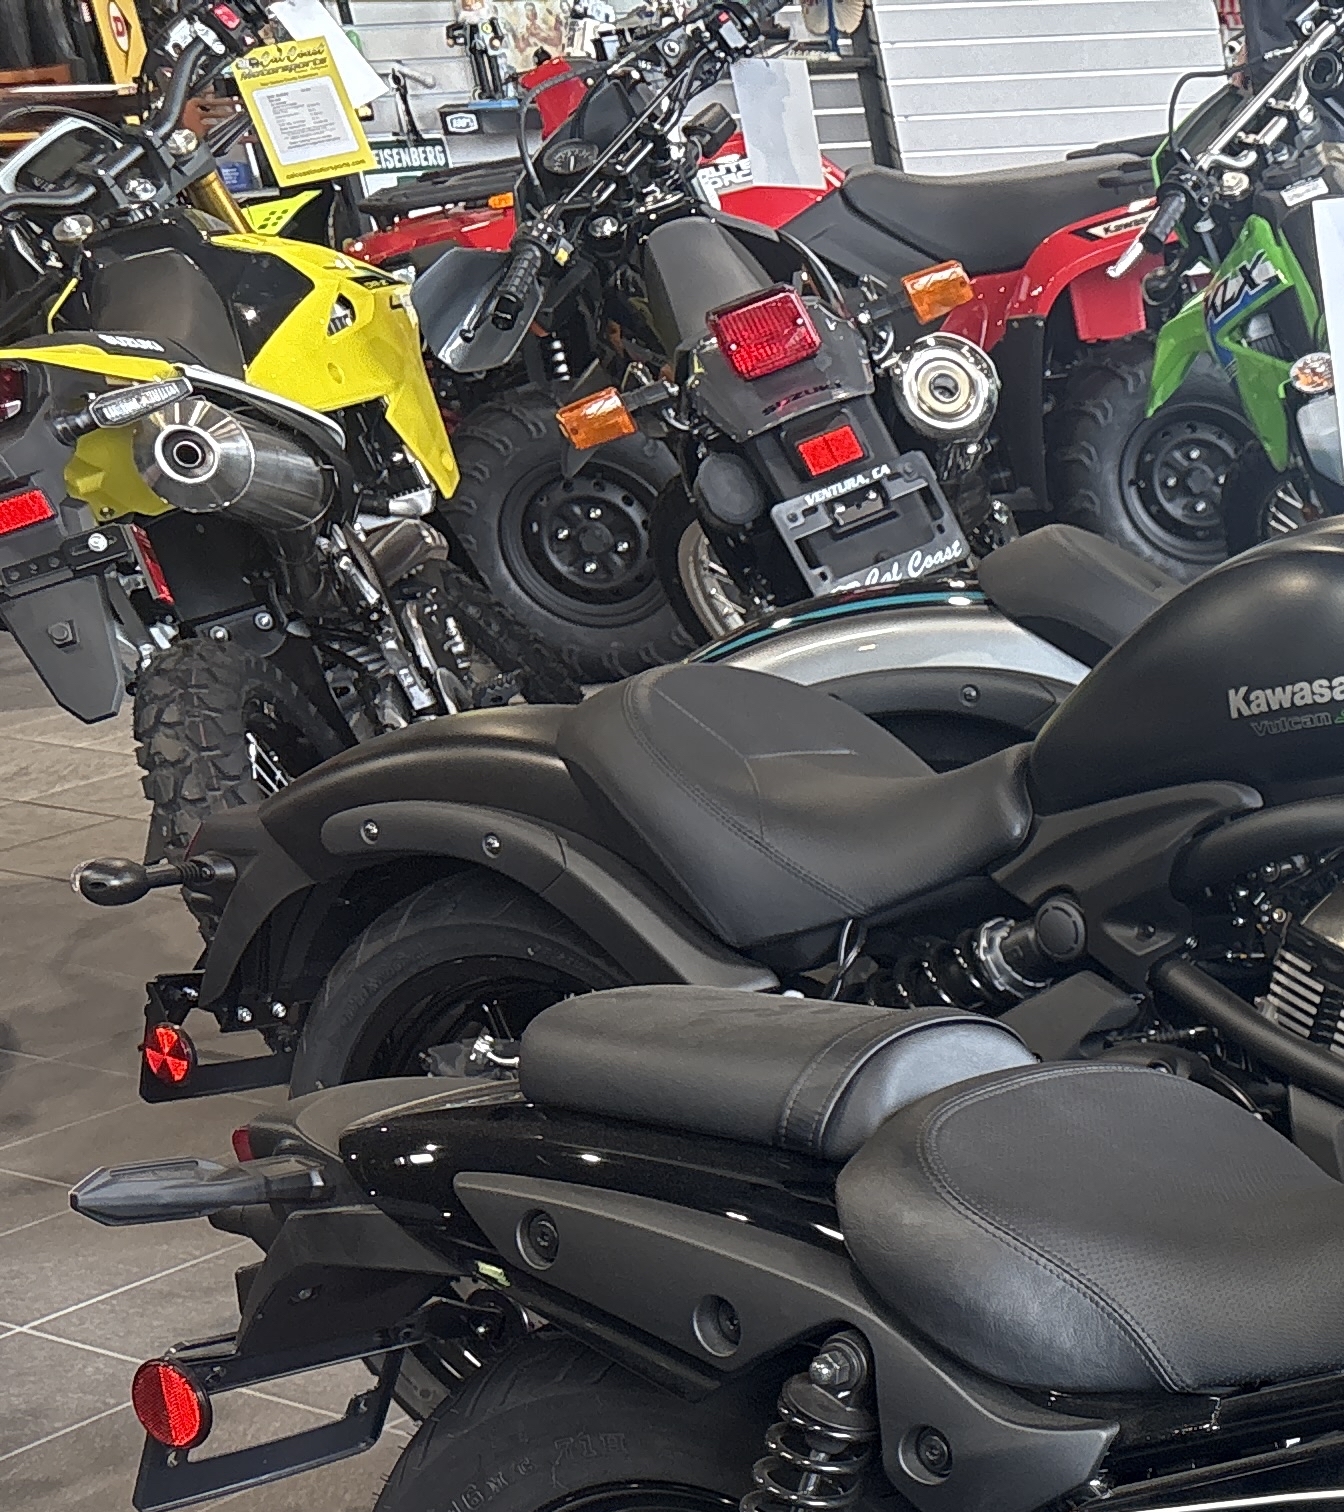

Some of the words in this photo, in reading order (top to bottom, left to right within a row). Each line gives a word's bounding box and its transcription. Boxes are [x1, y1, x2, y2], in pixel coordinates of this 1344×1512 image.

[372, 145, 446, 170] EISENBERG
[872, 464, 891, 480] CA
[864, 563, 902, 586] Cal
[907, 539, 963, 578] Coast
[1251, 712, 1332, 737] Vulcan
